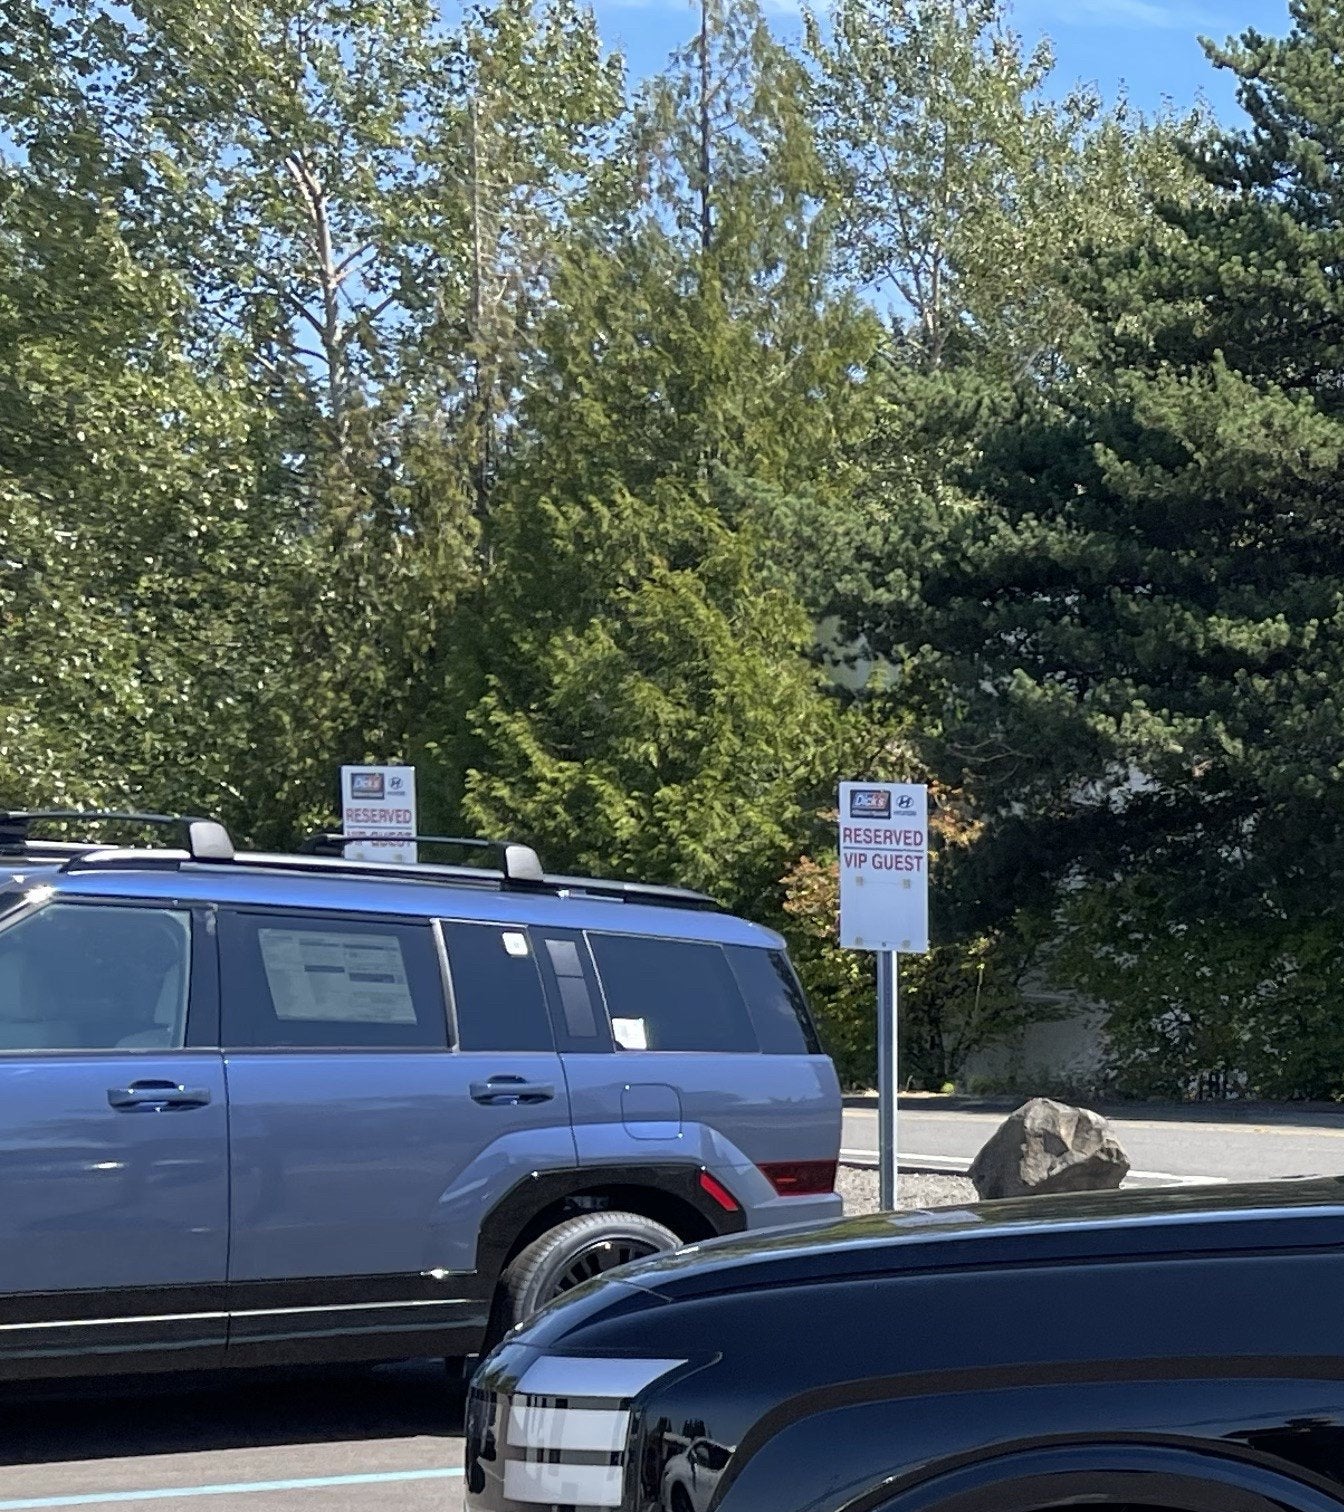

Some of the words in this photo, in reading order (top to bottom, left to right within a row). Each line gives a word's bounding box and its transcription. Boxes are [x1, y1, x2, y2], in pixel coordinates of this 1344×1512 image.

[346, 808, 411, 823] RESERVED
[843, 827, 923, 847] RESERVED
[844, 853, 867, 869] VIP
[872, 853, 923, 872] GUEST
